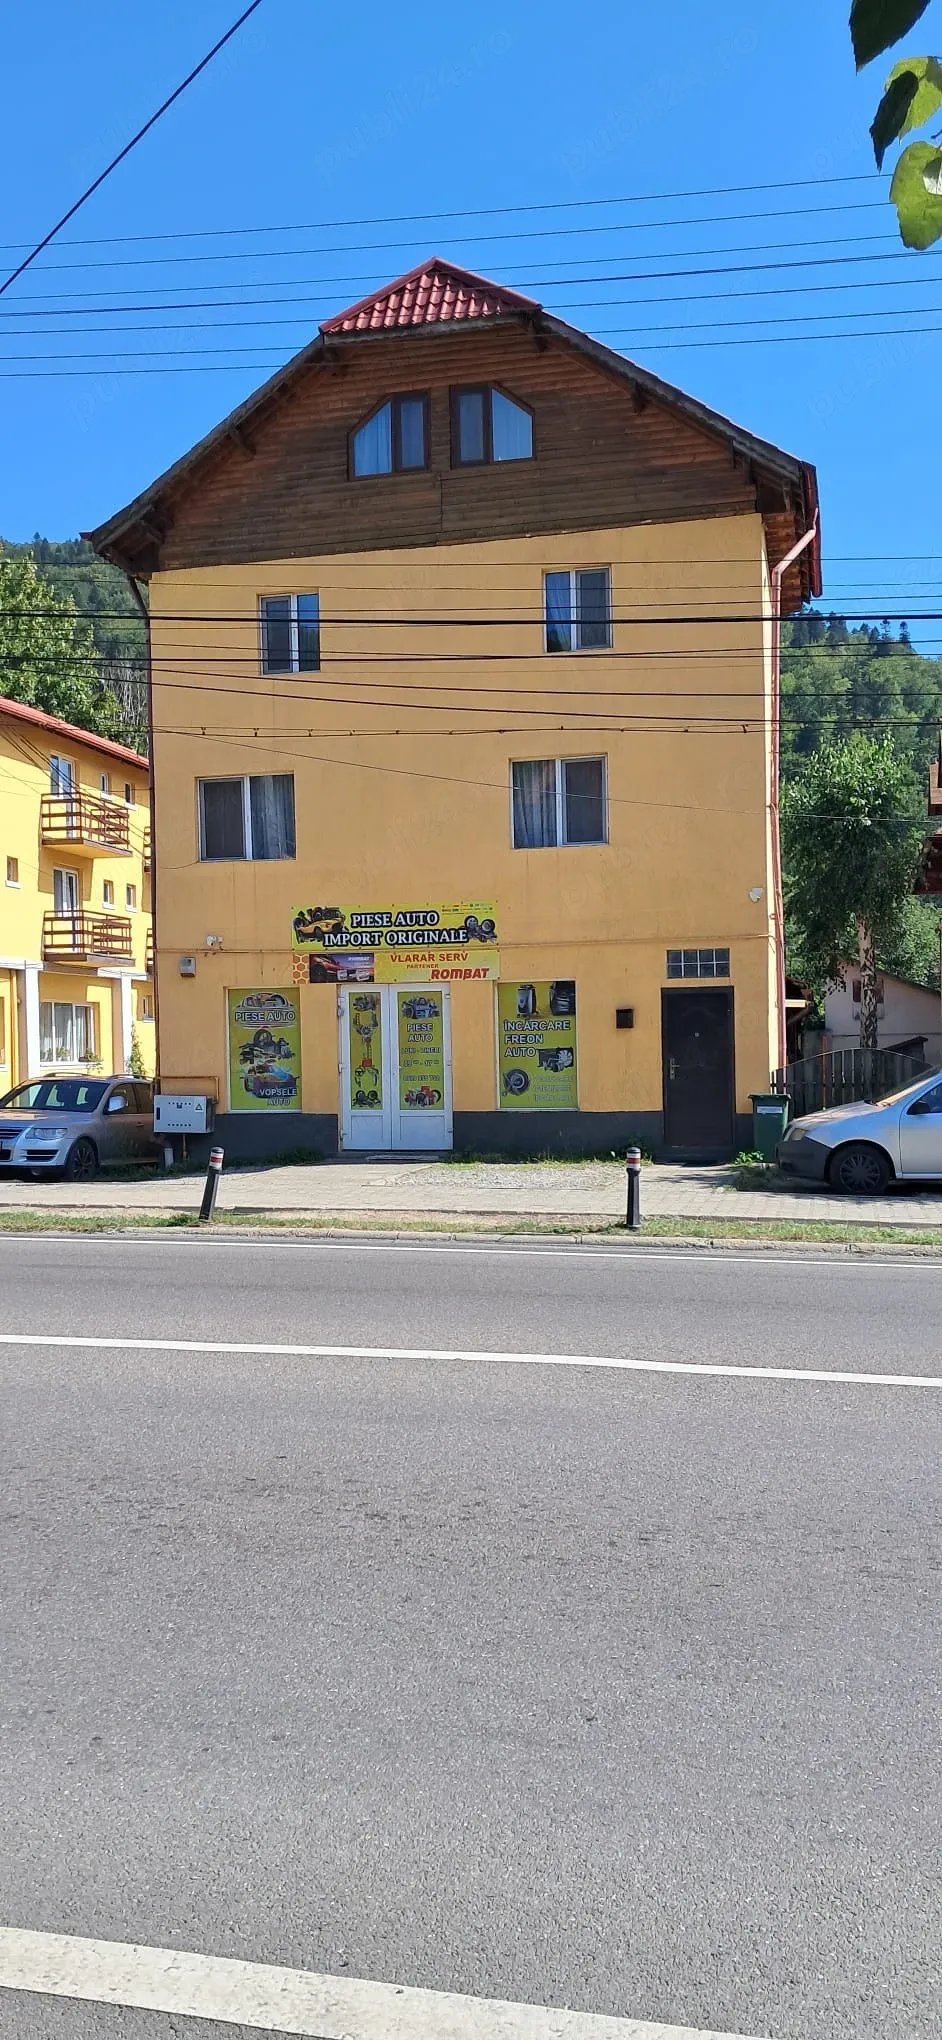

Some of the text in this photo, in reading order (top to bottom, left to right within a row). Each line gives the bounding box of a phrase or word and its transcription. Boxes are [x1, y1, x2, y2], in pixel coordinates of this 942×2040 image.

[351, 911, 438, 928] PIESE AUTO
[324, 929, 468, 946] IMPORT ORIGINALE
[390, 952, 469, 963] VLARAR SERV
[431, 967, 490, 980] ROMBAT
[235, 1011, 295, 1022] PIESE AUTO
[407, 1023, 433, 1032] PIESE
[408, 1034, 433, 1042] AUTO
[504, 1034, 544, 1044] FREON
[504, 1047, 536, 1058] AUTO
[259, 1087, 297, 1097] VOPSELE
